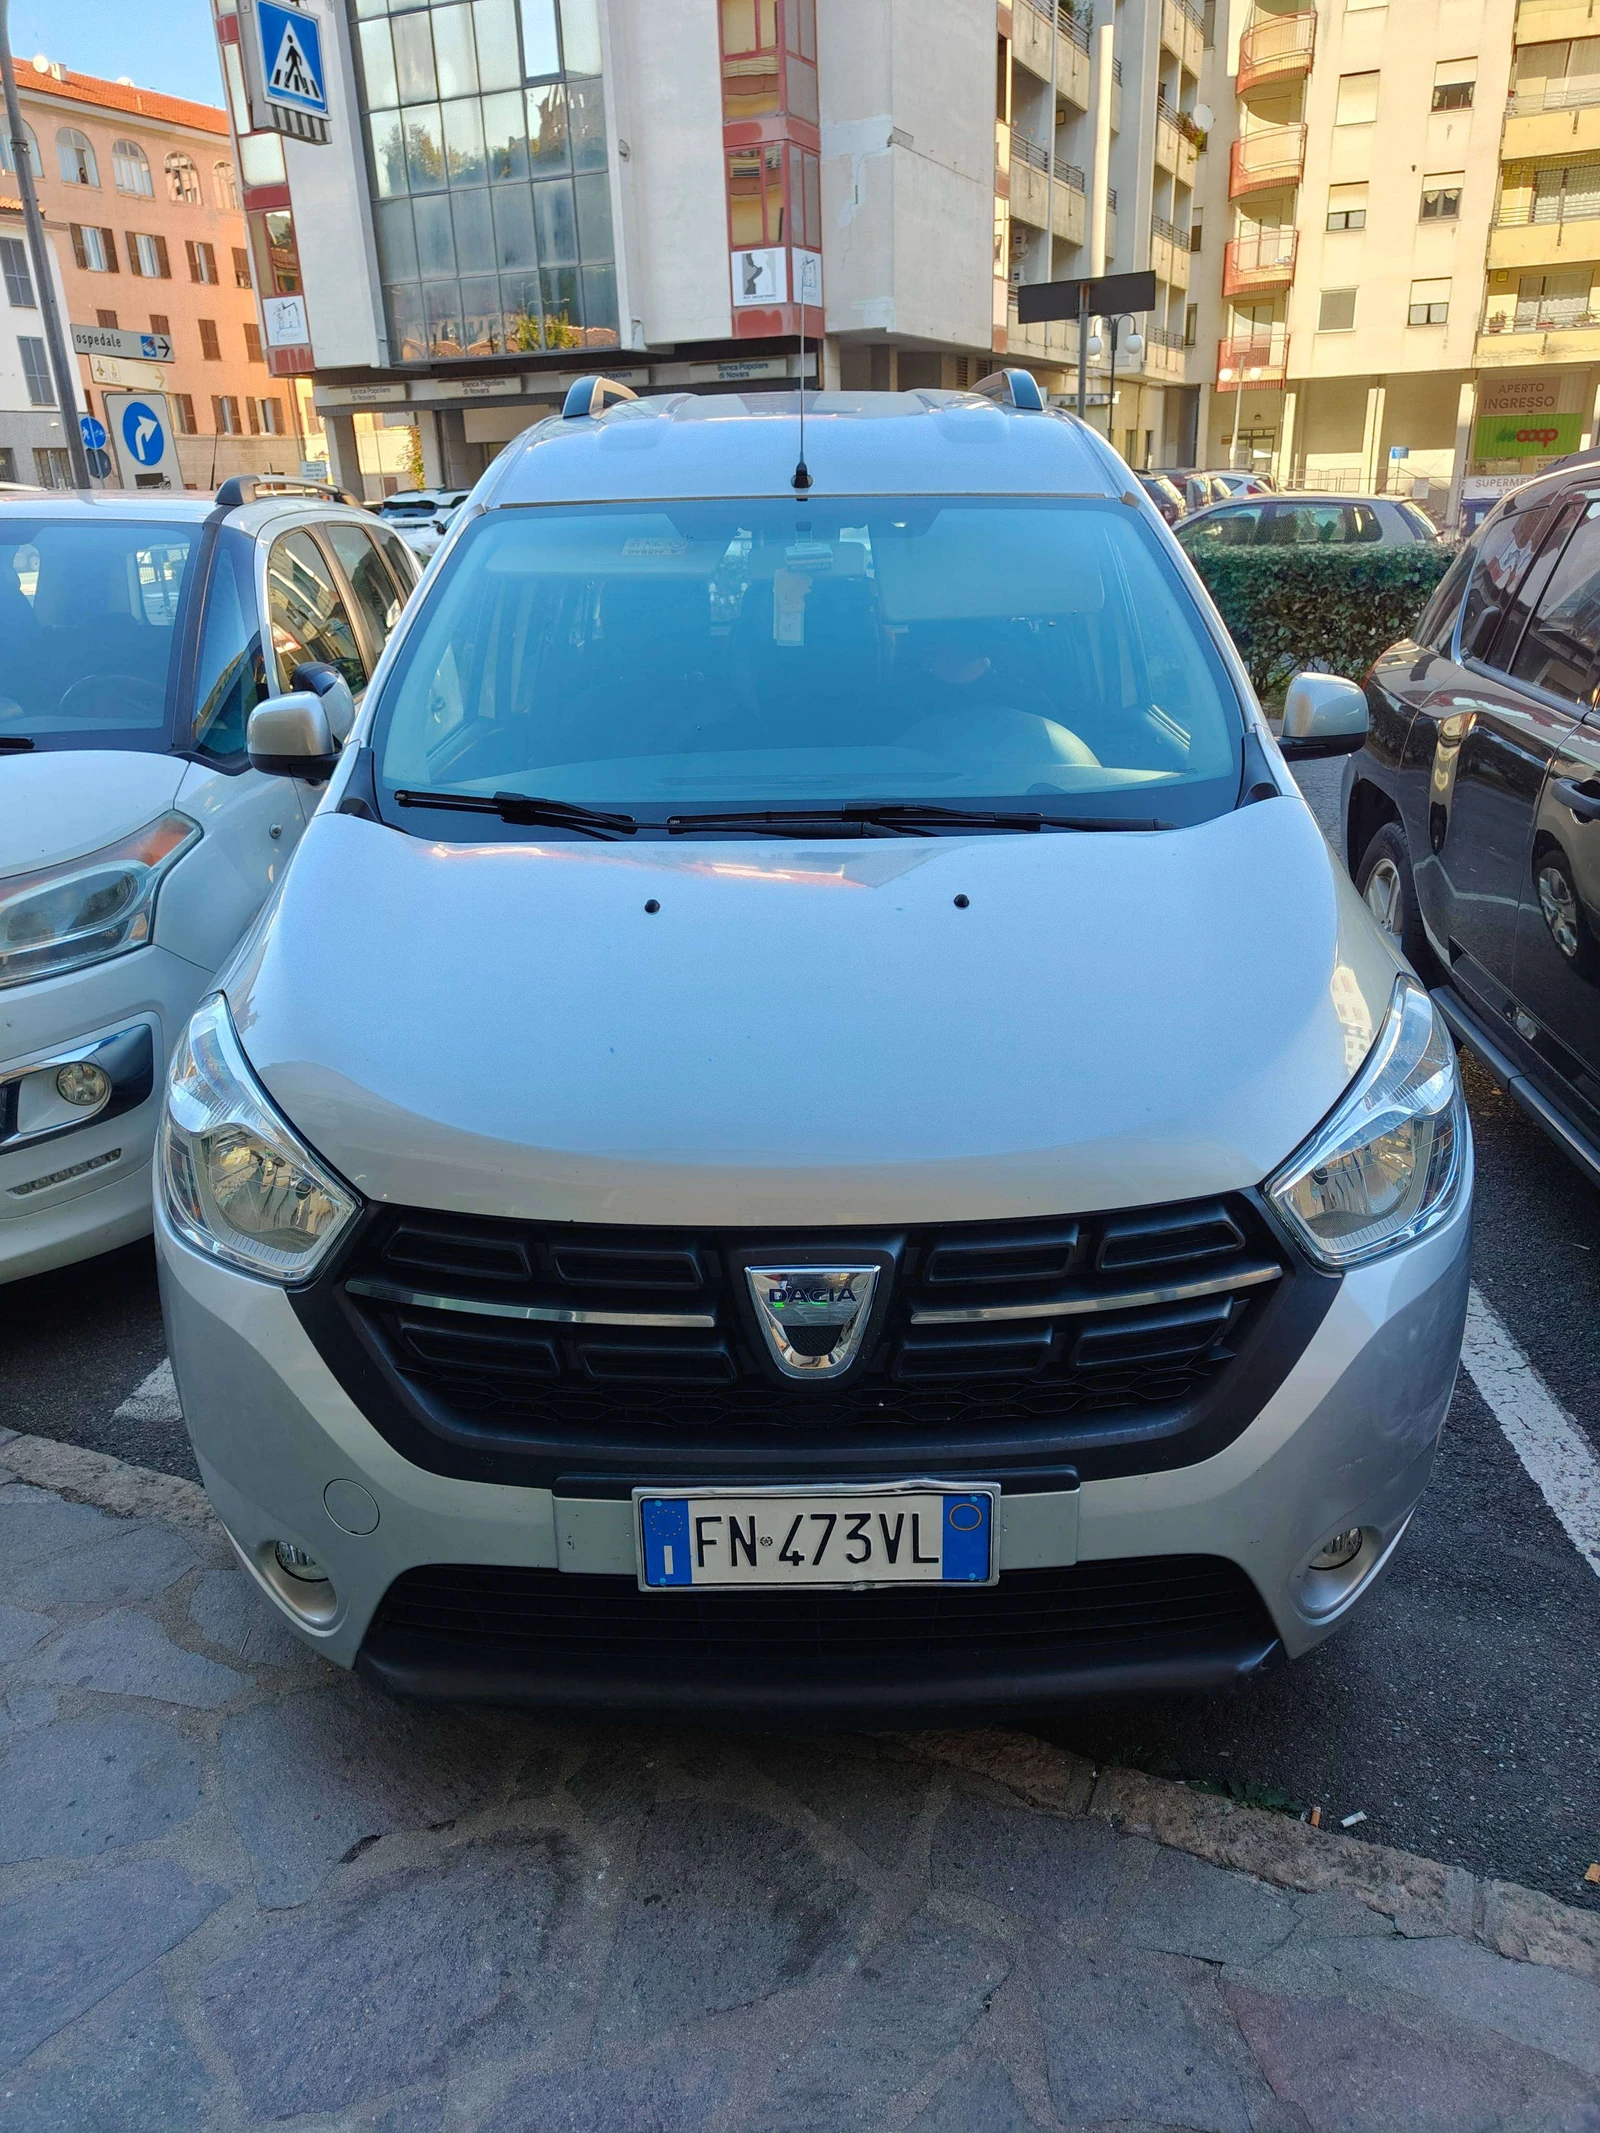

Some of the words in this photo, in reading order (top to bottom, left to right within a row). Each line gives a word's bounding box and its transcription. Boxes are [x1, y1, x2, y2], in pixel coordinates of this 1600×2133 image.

[76, 333, 121, 348] ospedale
[717, 363, 738, 372] Banca
[739, 361, 769, 372] Popolare
[726, 371, 750, 379] Novara
[1498, 383, 1545, 395] APERTO
[1484, 396, 1555, 410] INGRESSO
[768, 1287, 857, 1304] DACIA
[695, 1514, 758, 1568] FN
[777, 1512, 941, 1568] 473VL
